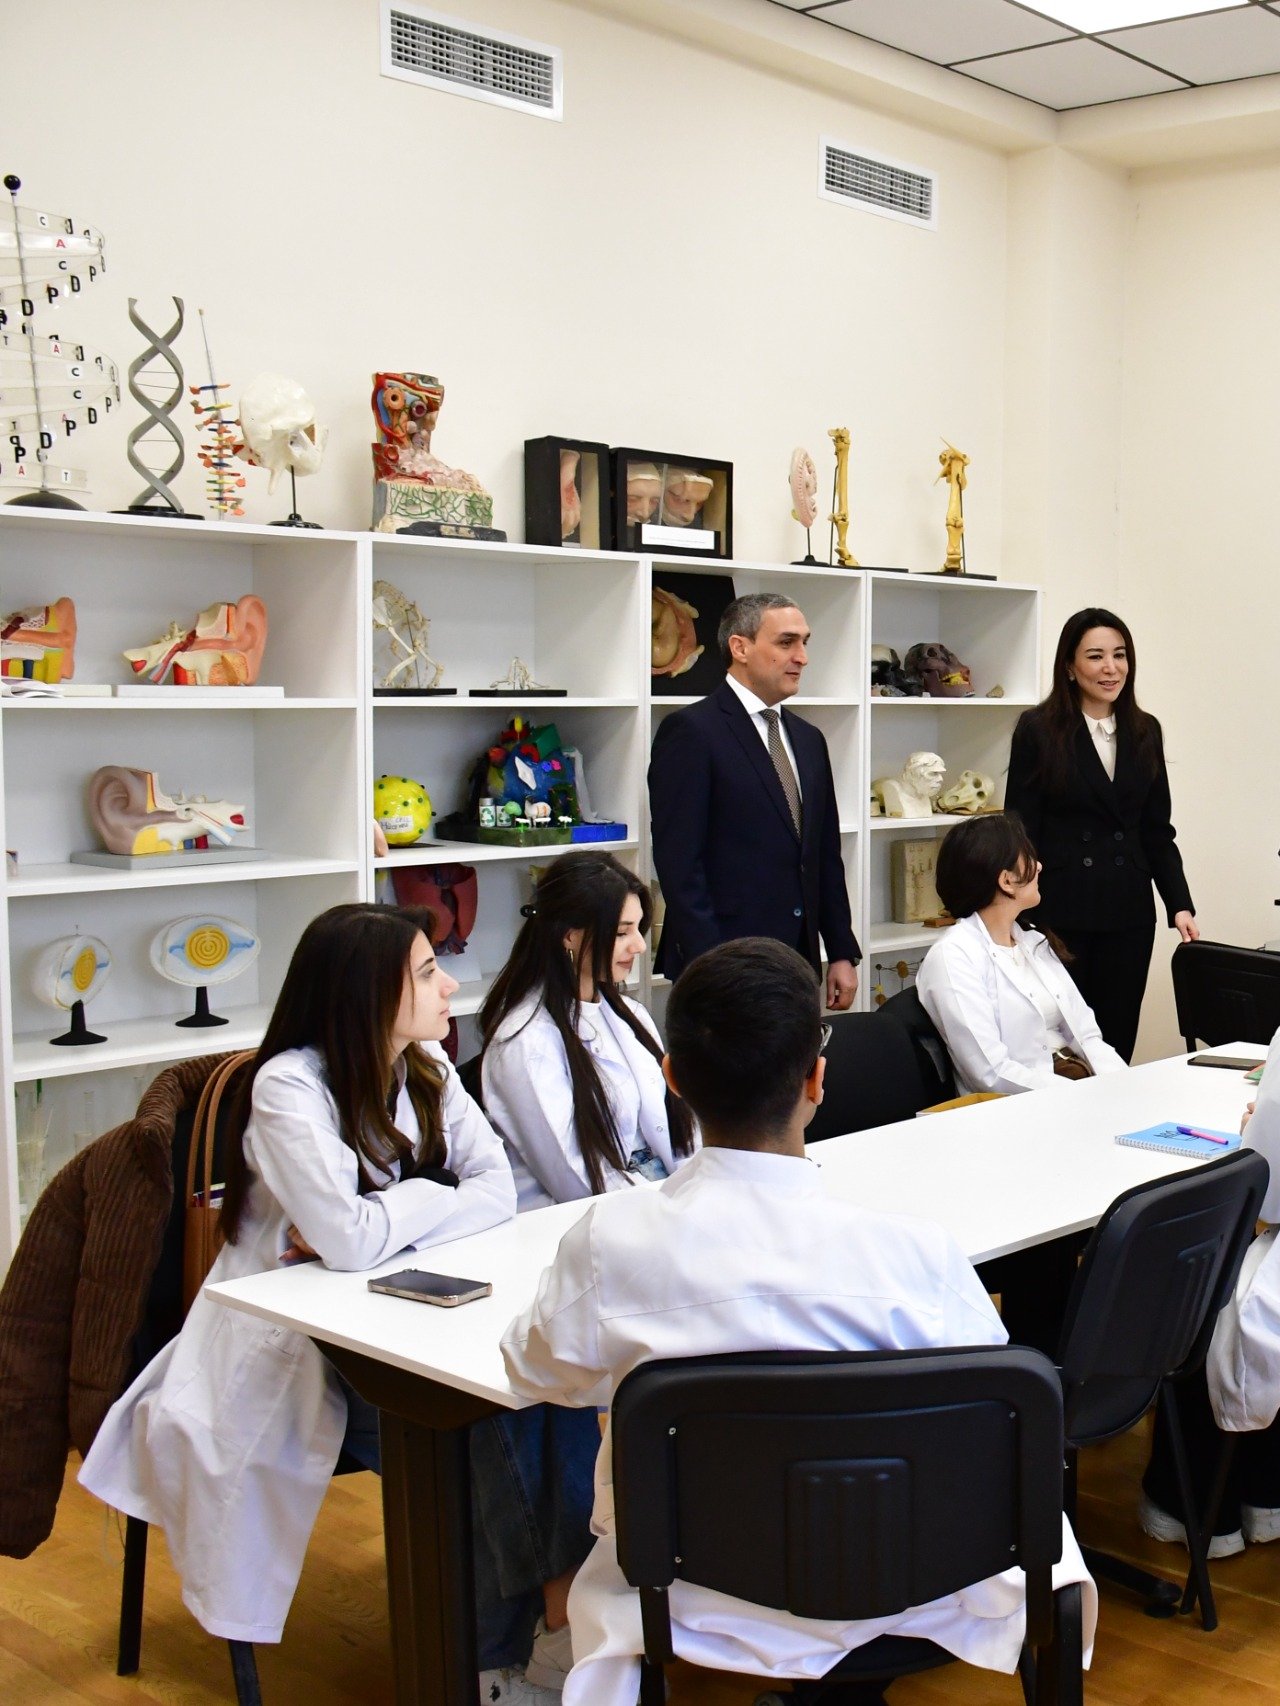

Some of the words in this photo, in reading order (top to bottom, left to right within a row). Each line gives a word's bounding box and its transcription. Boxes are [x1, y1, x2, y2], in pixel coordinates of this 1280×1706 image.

[40, 216, 46, 226] C
[56, 238, 66, 248] A
[58, 260, 67, 270] C
[89, 265, 97, 282] P
[70, 274, 81, 293] D
[46, 286, 59, 304] P
[21, 298, 34, 316] D
[53, 344, 60, 354] A
[71, 367, 80, 376] C
[73, 390, 82, 399] C
[105, 396, 112, 413] P
[88, 407, 97, 424] D
[11, 421, 17, 430] T
[65, 420, 77, 436] P
[40, 432, 52, 449] D
[14, 446, 26, 463] P
[19, 465, 25, 475] A
